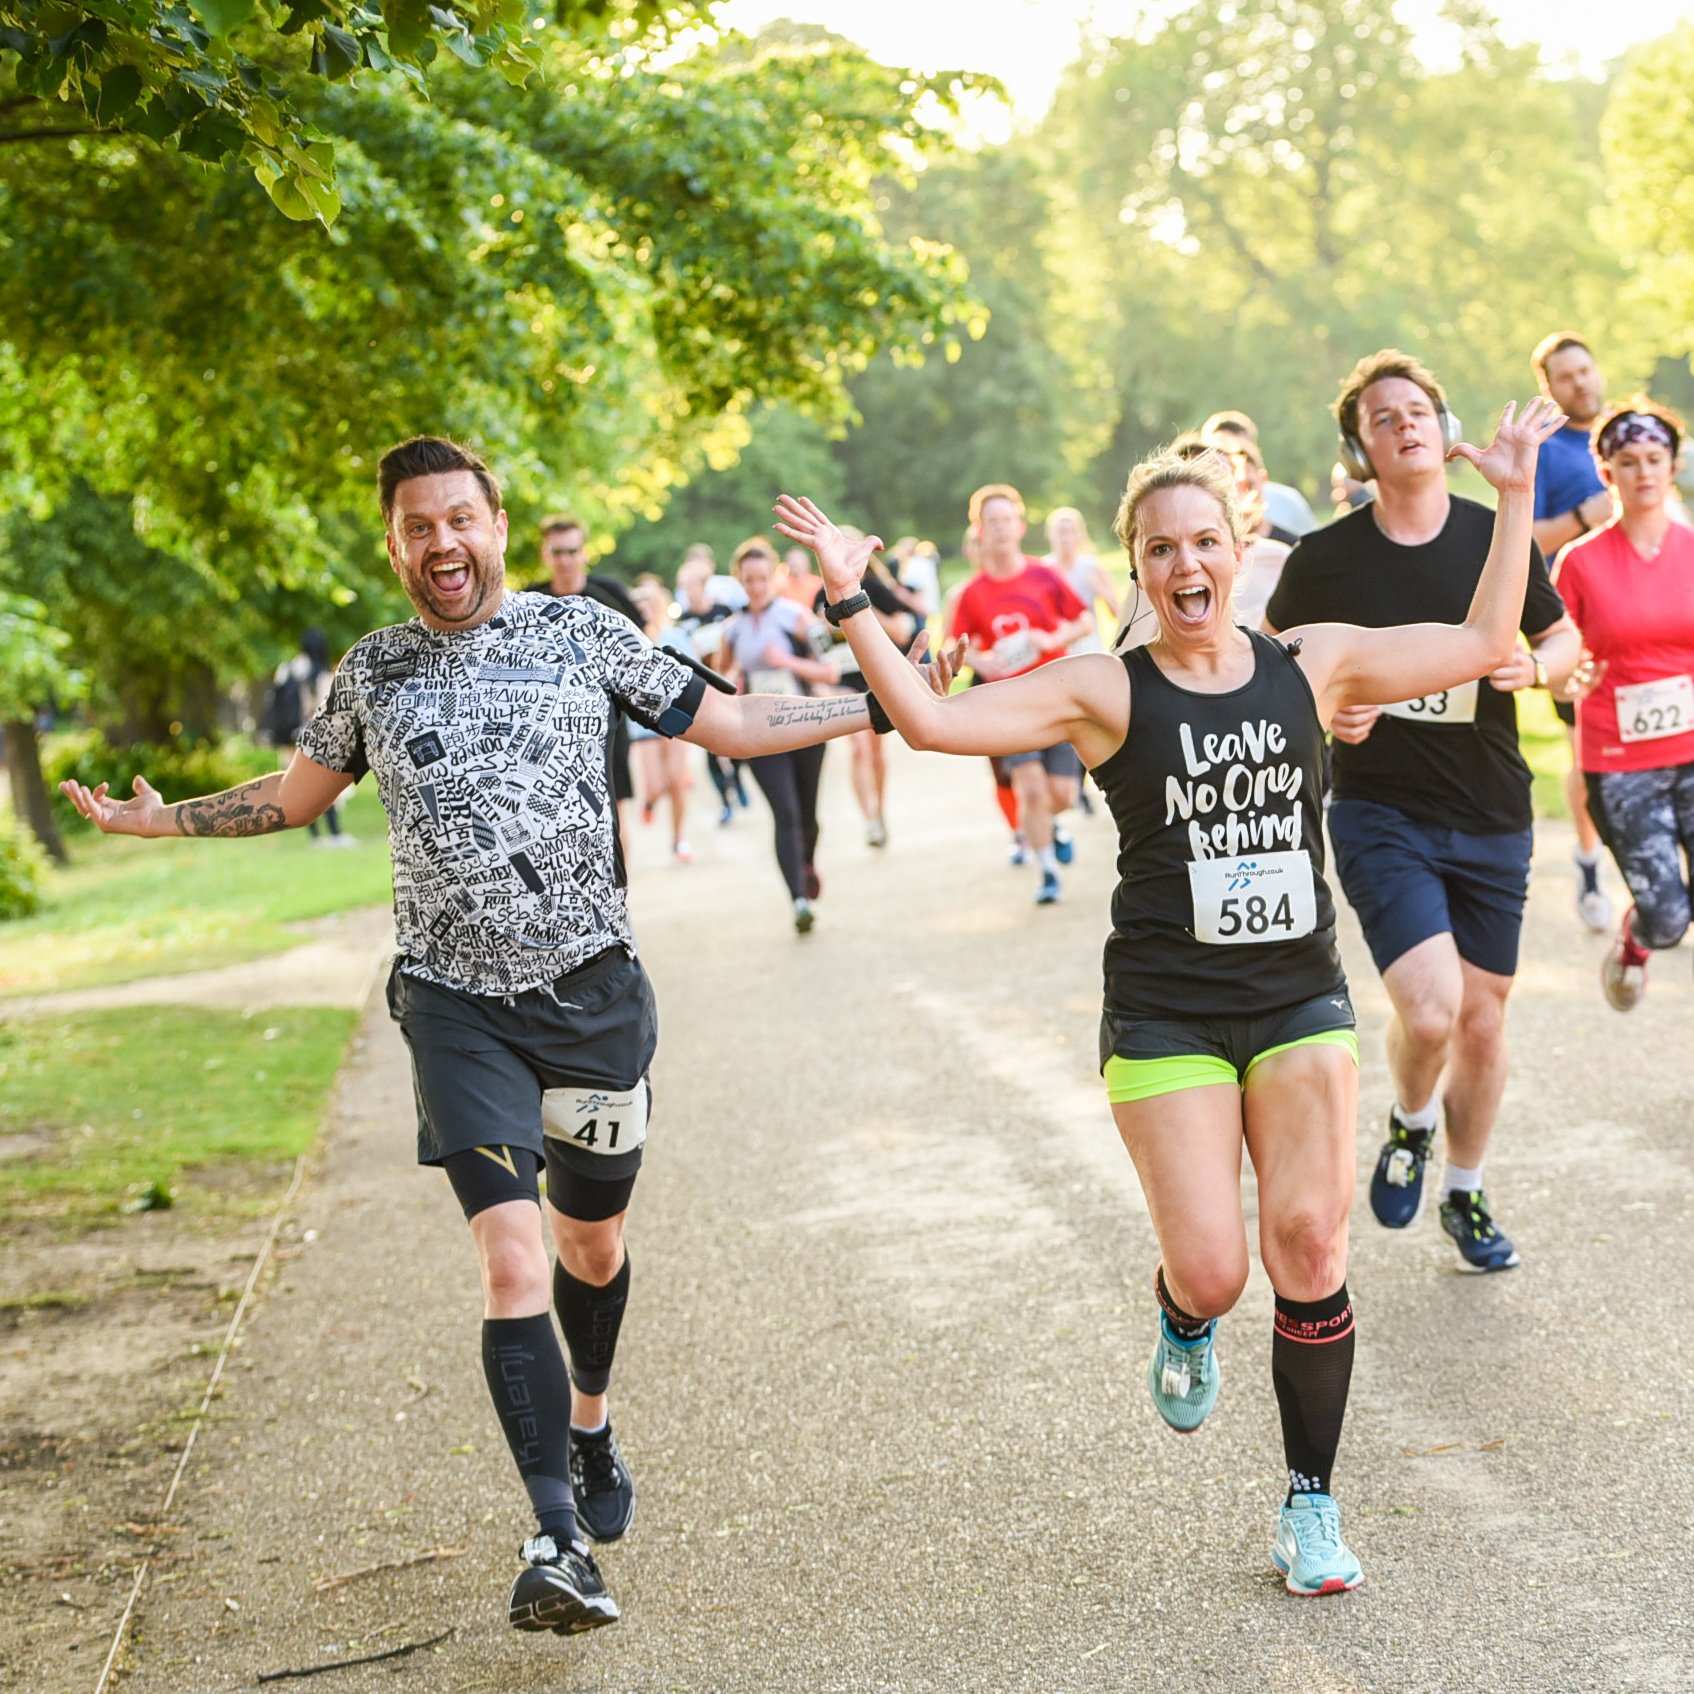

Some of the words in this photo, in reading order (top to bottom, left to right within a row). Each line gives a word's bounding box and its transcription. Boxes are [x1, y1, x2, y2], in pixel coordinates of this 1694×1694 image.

[424, 681, 457, 690] GIVE
[535, 693, 555, 722] GIVE
[1633, 705, 1681, 734] 622
[1165, 775, 1218, 826] No
[1217, 893, 1295, 936] 584
[573, 1119, 620, 1148] 41
[491, 1342, 542, 1467] kalenji
